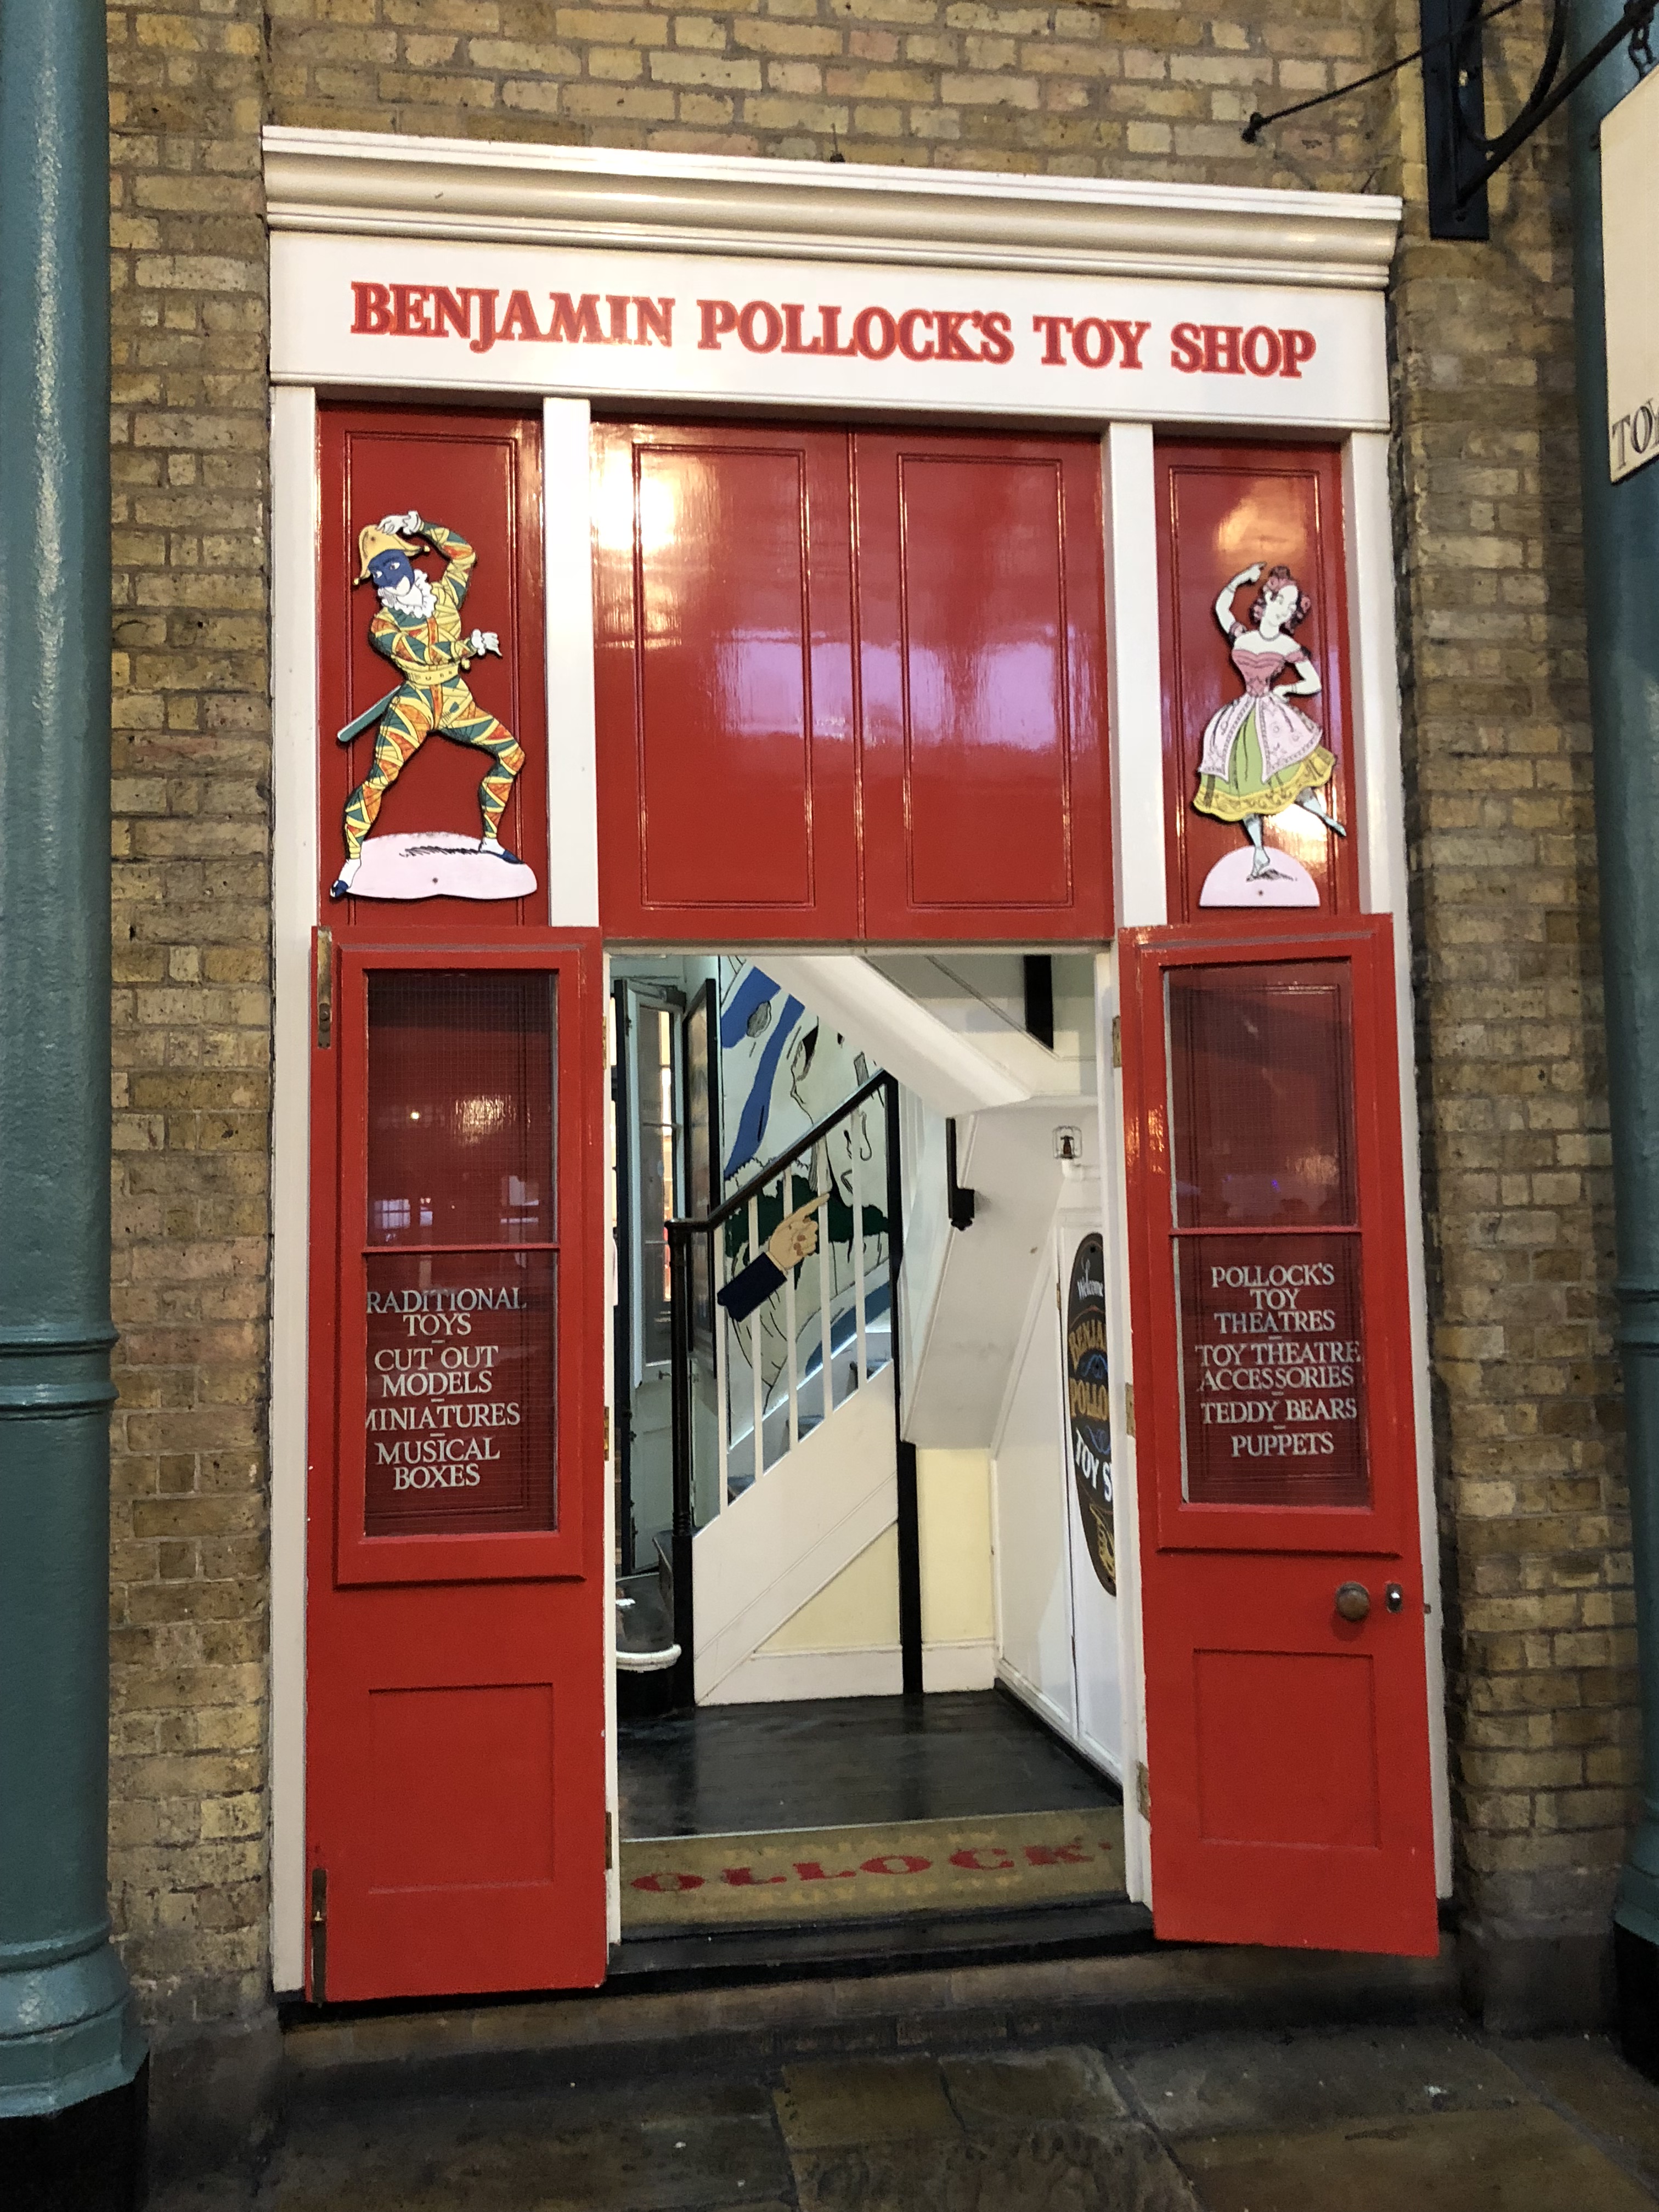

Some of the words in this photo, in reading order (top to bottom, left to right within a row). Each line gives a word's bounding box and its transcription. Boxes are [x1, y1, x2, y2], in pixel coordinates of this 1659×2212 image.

[351, 281, 676, 354] BENJAMIN
[697, 299, 1014, 365] POLLOCK'S
[1032, 314, 1152, 370] TOY
[1171, 321, 1318, 379] SHOP
[1211, 1262, 1335, 1288] POLLOCK'S
[1250, 1288, 1300, 1311] TOY
[403, 1312, 472, 1337] TOYS
[1214, 1309, 1336, 1334] THEATRES
[375, 1347, 433, 1372] CUT
[441, 1345, 499, 1369] OUT
[1195, 1343, 1248, 1367] TOY
[1251, 1340, 1361, 1365] THEATRE
[380, 1370, 493, 1398] MODELS
[1196, 1365, 1355, 1392] ACCESSORIES
[1200, 1400, 1281, 1425] TEDDY
[1285, 1397, 1358, 1421] BEARS
[374, 1437, 500, 1465] MUSICAL
[1231, 1431, 1335, 1458] PUPPETS
[1075, 1427, 1100, 1490] TOY
[393, 1463, 481, 1491] BOXES
